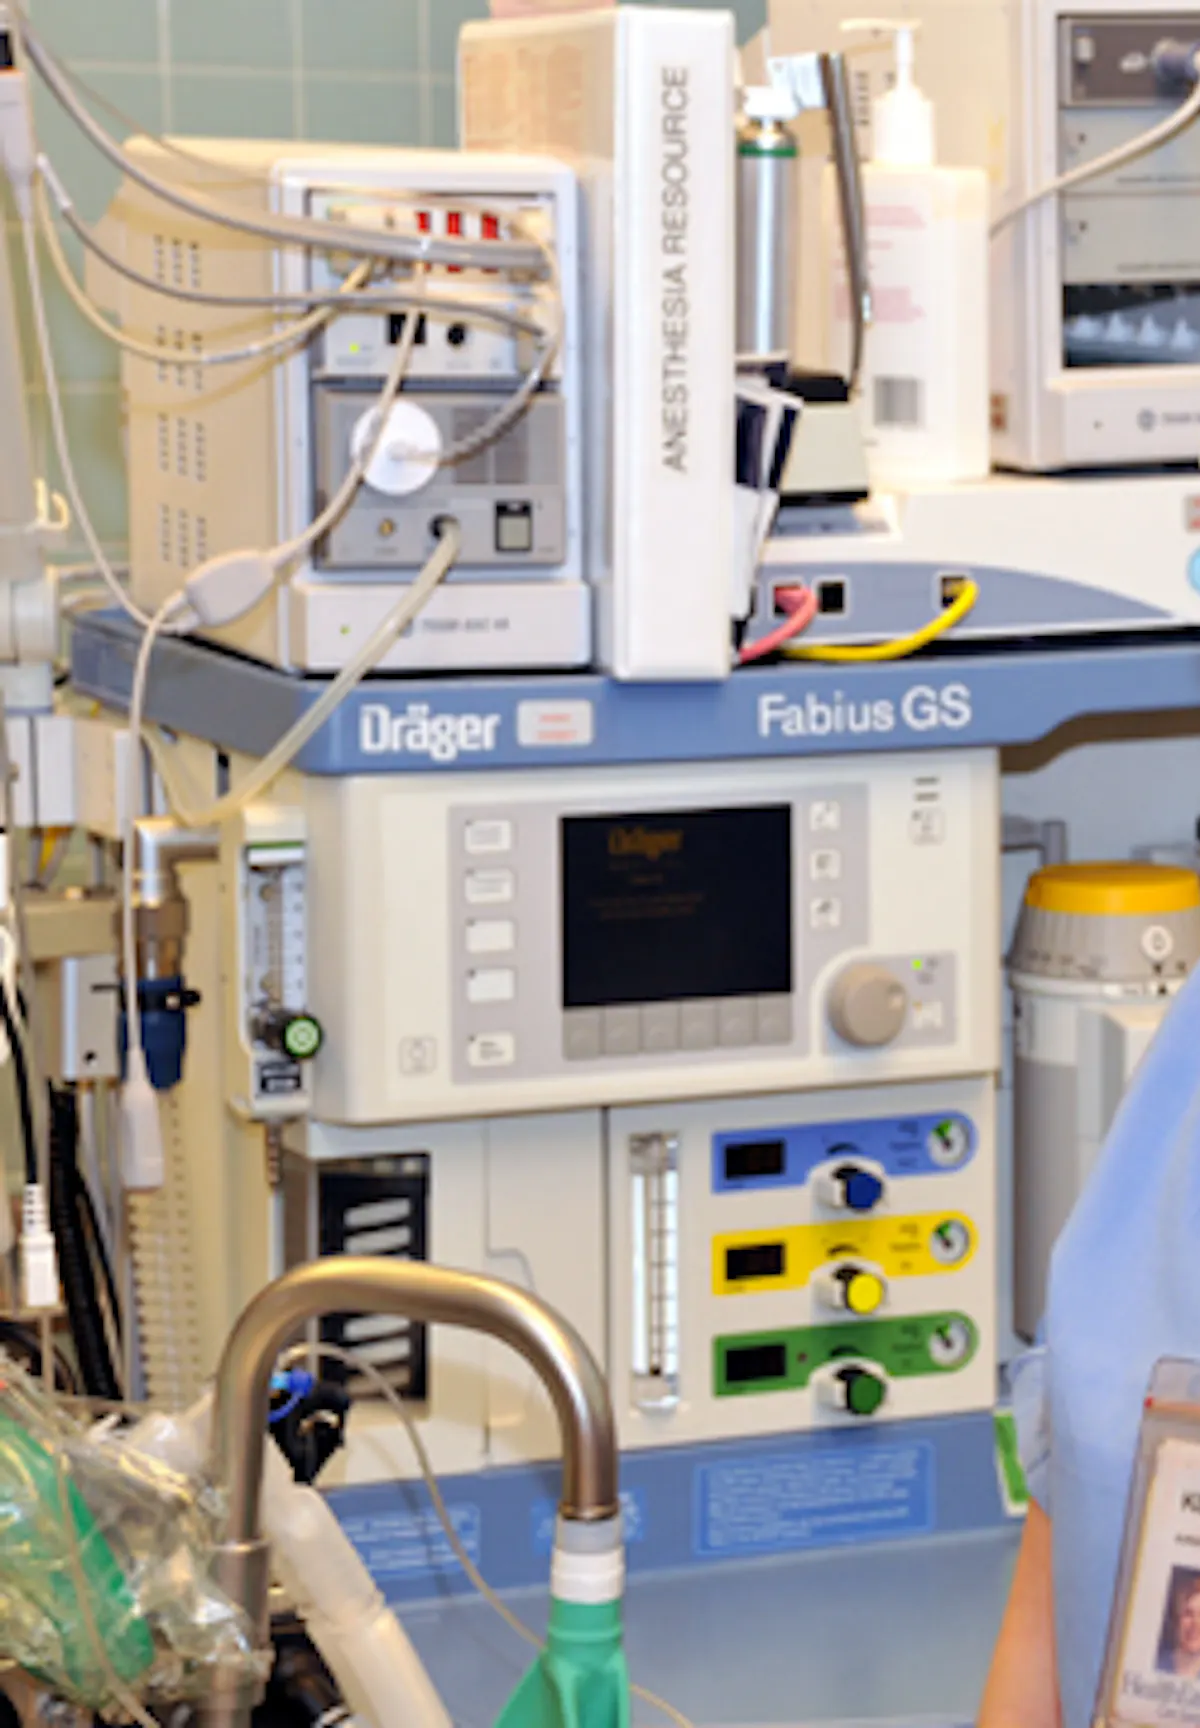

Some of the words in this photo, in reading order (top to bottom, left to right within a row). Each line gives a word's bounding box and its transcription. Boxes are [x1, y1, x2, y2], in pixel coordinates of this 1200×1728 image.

[661, 66, 689, 255] RESOURCE
[661, 261, 689, 475] ANESTHESIA
[359, 702, 501, 762] Dräger
[757, 689, 895, 738] Fabius
[901, 682, 973, 732] GS
